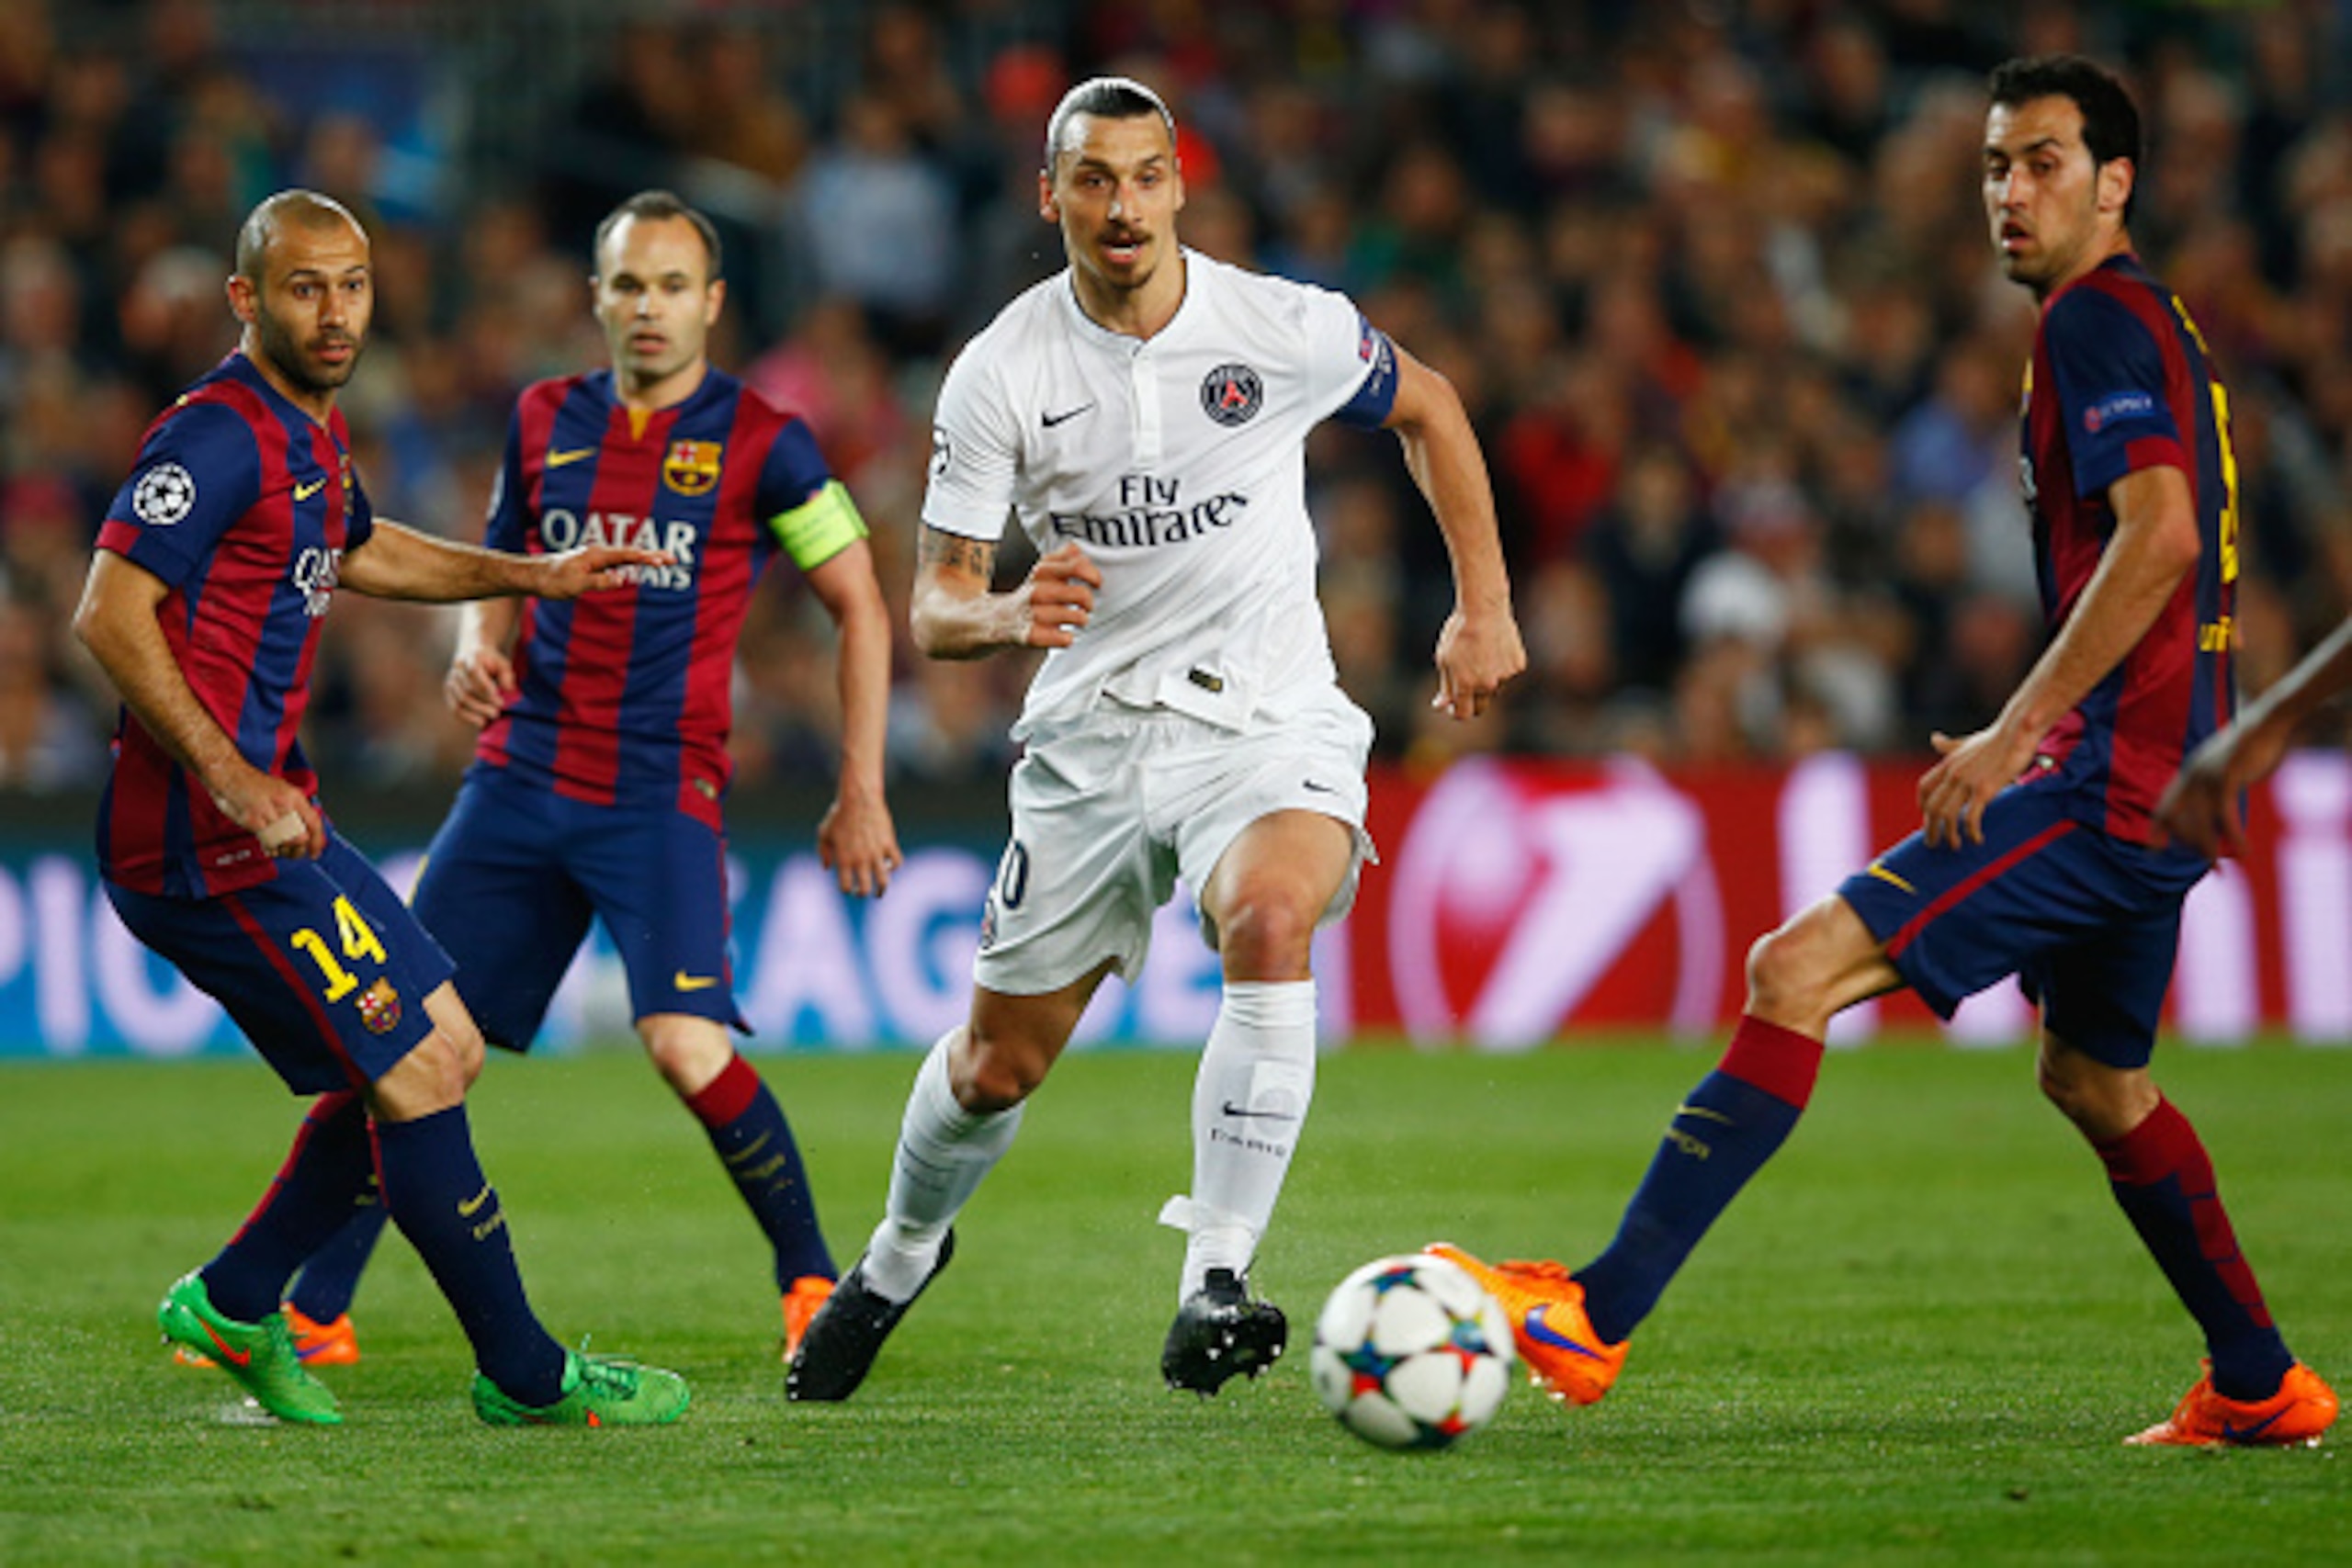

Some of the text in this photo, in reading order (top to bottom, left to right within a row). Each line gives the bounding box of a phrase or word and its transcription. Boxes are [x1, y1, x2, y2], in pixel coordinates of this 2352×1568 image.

[1119, 476, 1179, 504] Fly
[542, 508, 695, 565] QATAR
[291, 893, 388, 1004] 14
